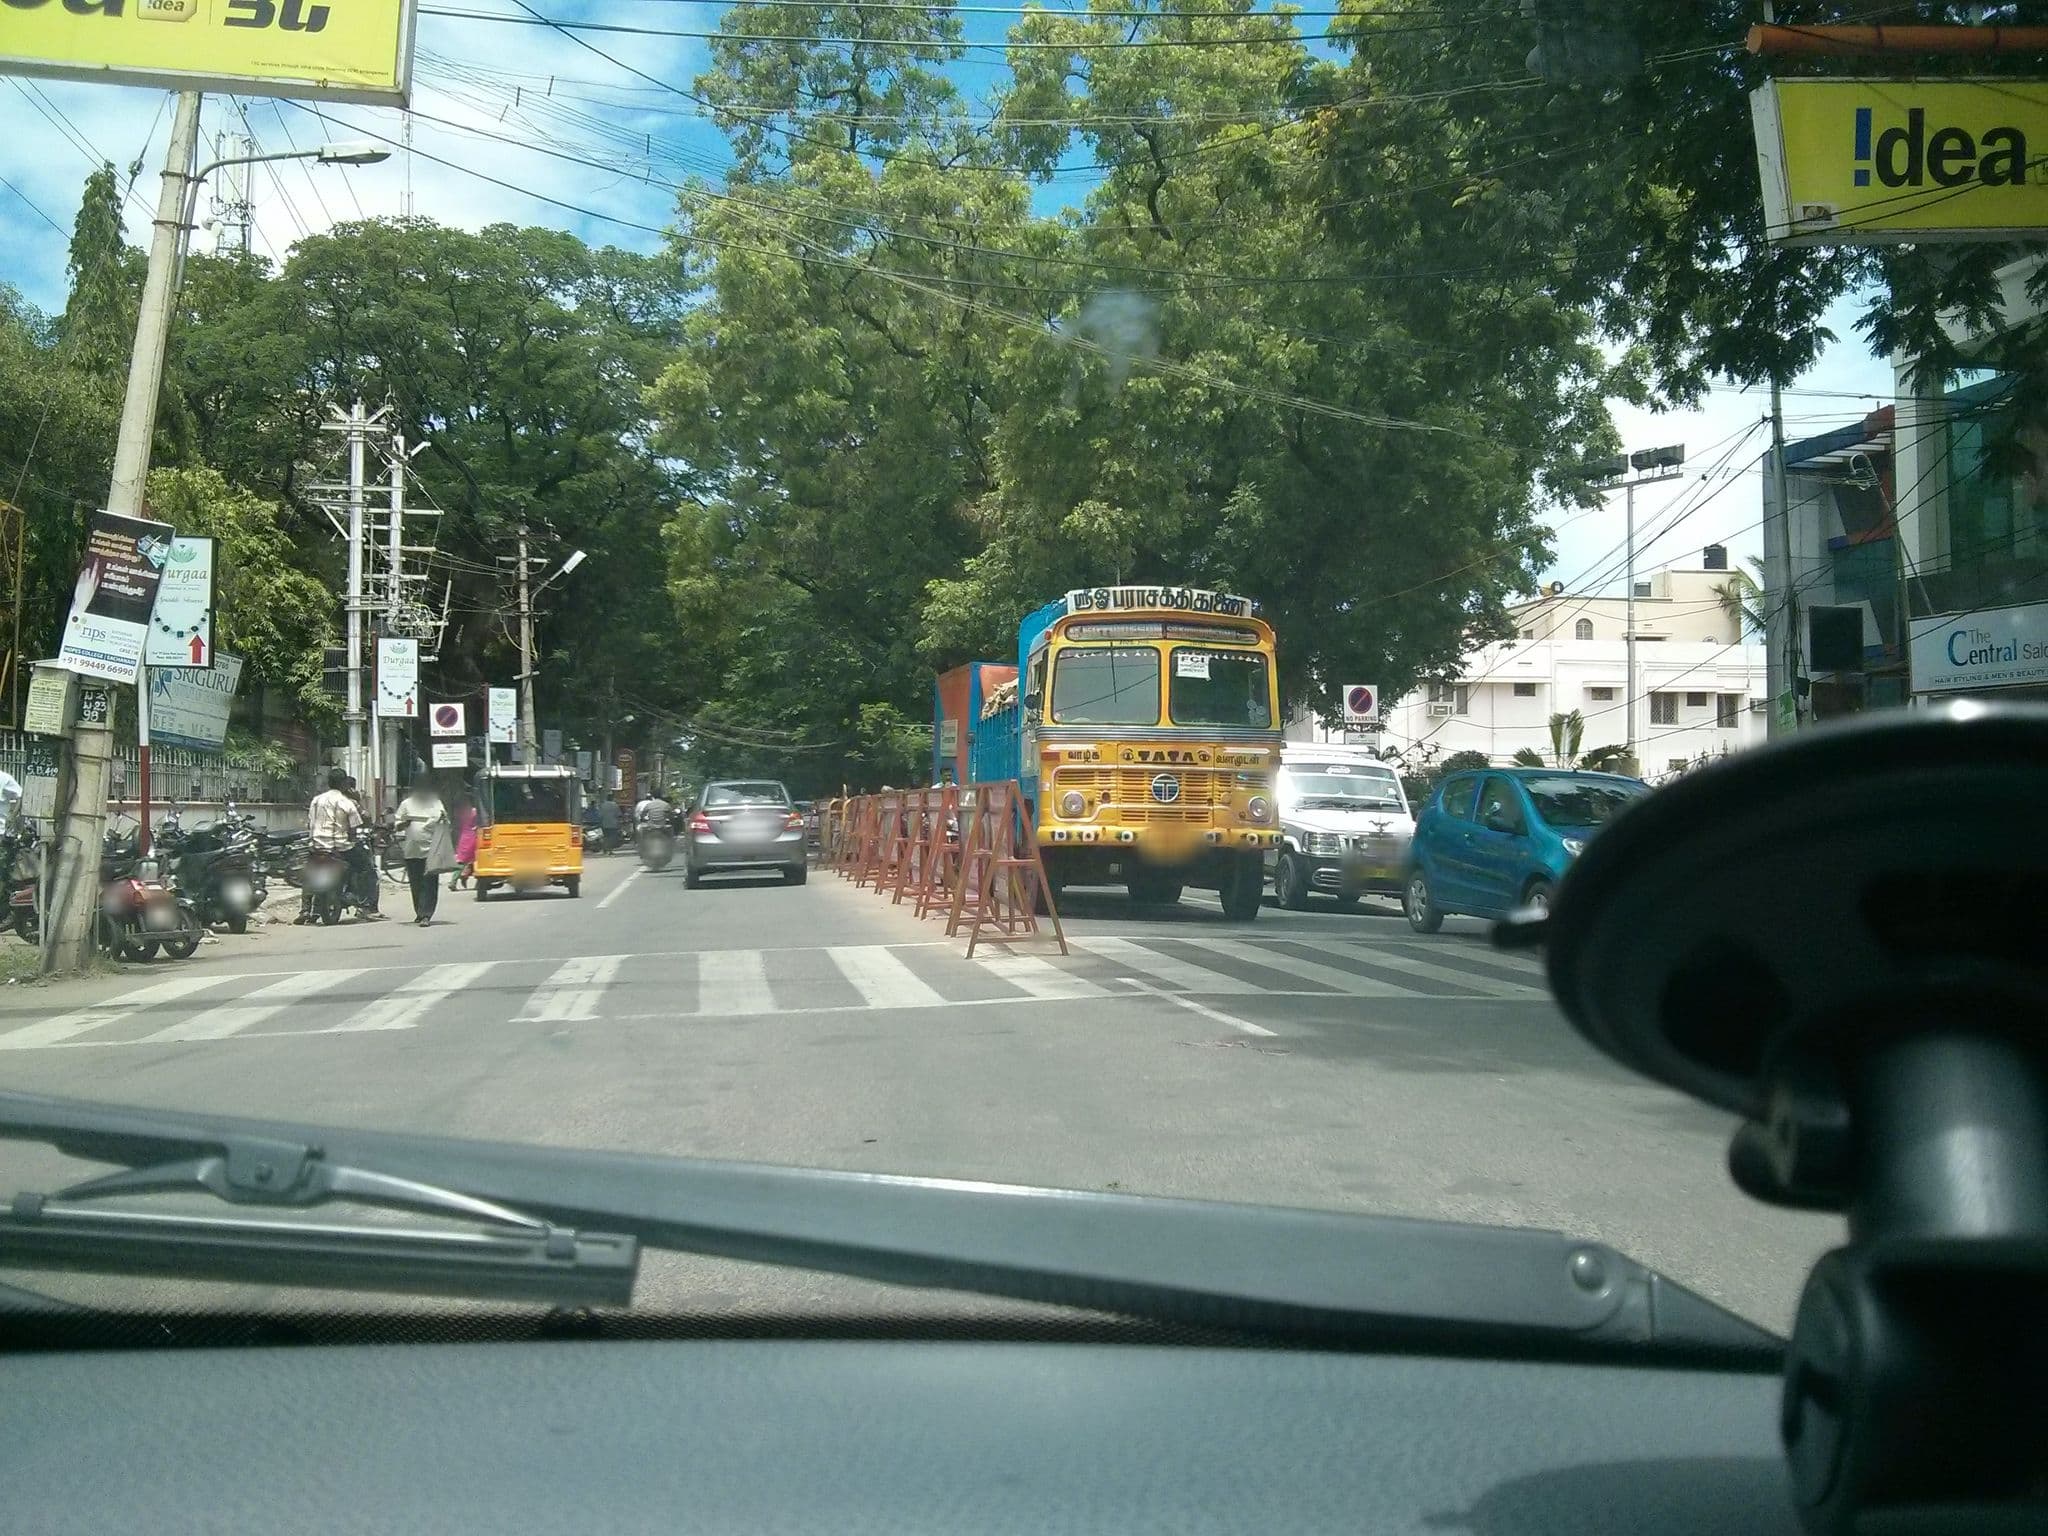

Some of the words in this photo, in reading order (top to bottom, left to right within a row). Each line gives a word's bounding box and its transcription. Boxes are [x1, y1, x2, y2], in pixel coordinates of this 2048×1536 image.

[168, 569, 208, 584] urgaa
[1968, 628, 1992, 644] The
[1948, 630, 2018, 667] Central
[1138, 750, 1195, 762] TATA
